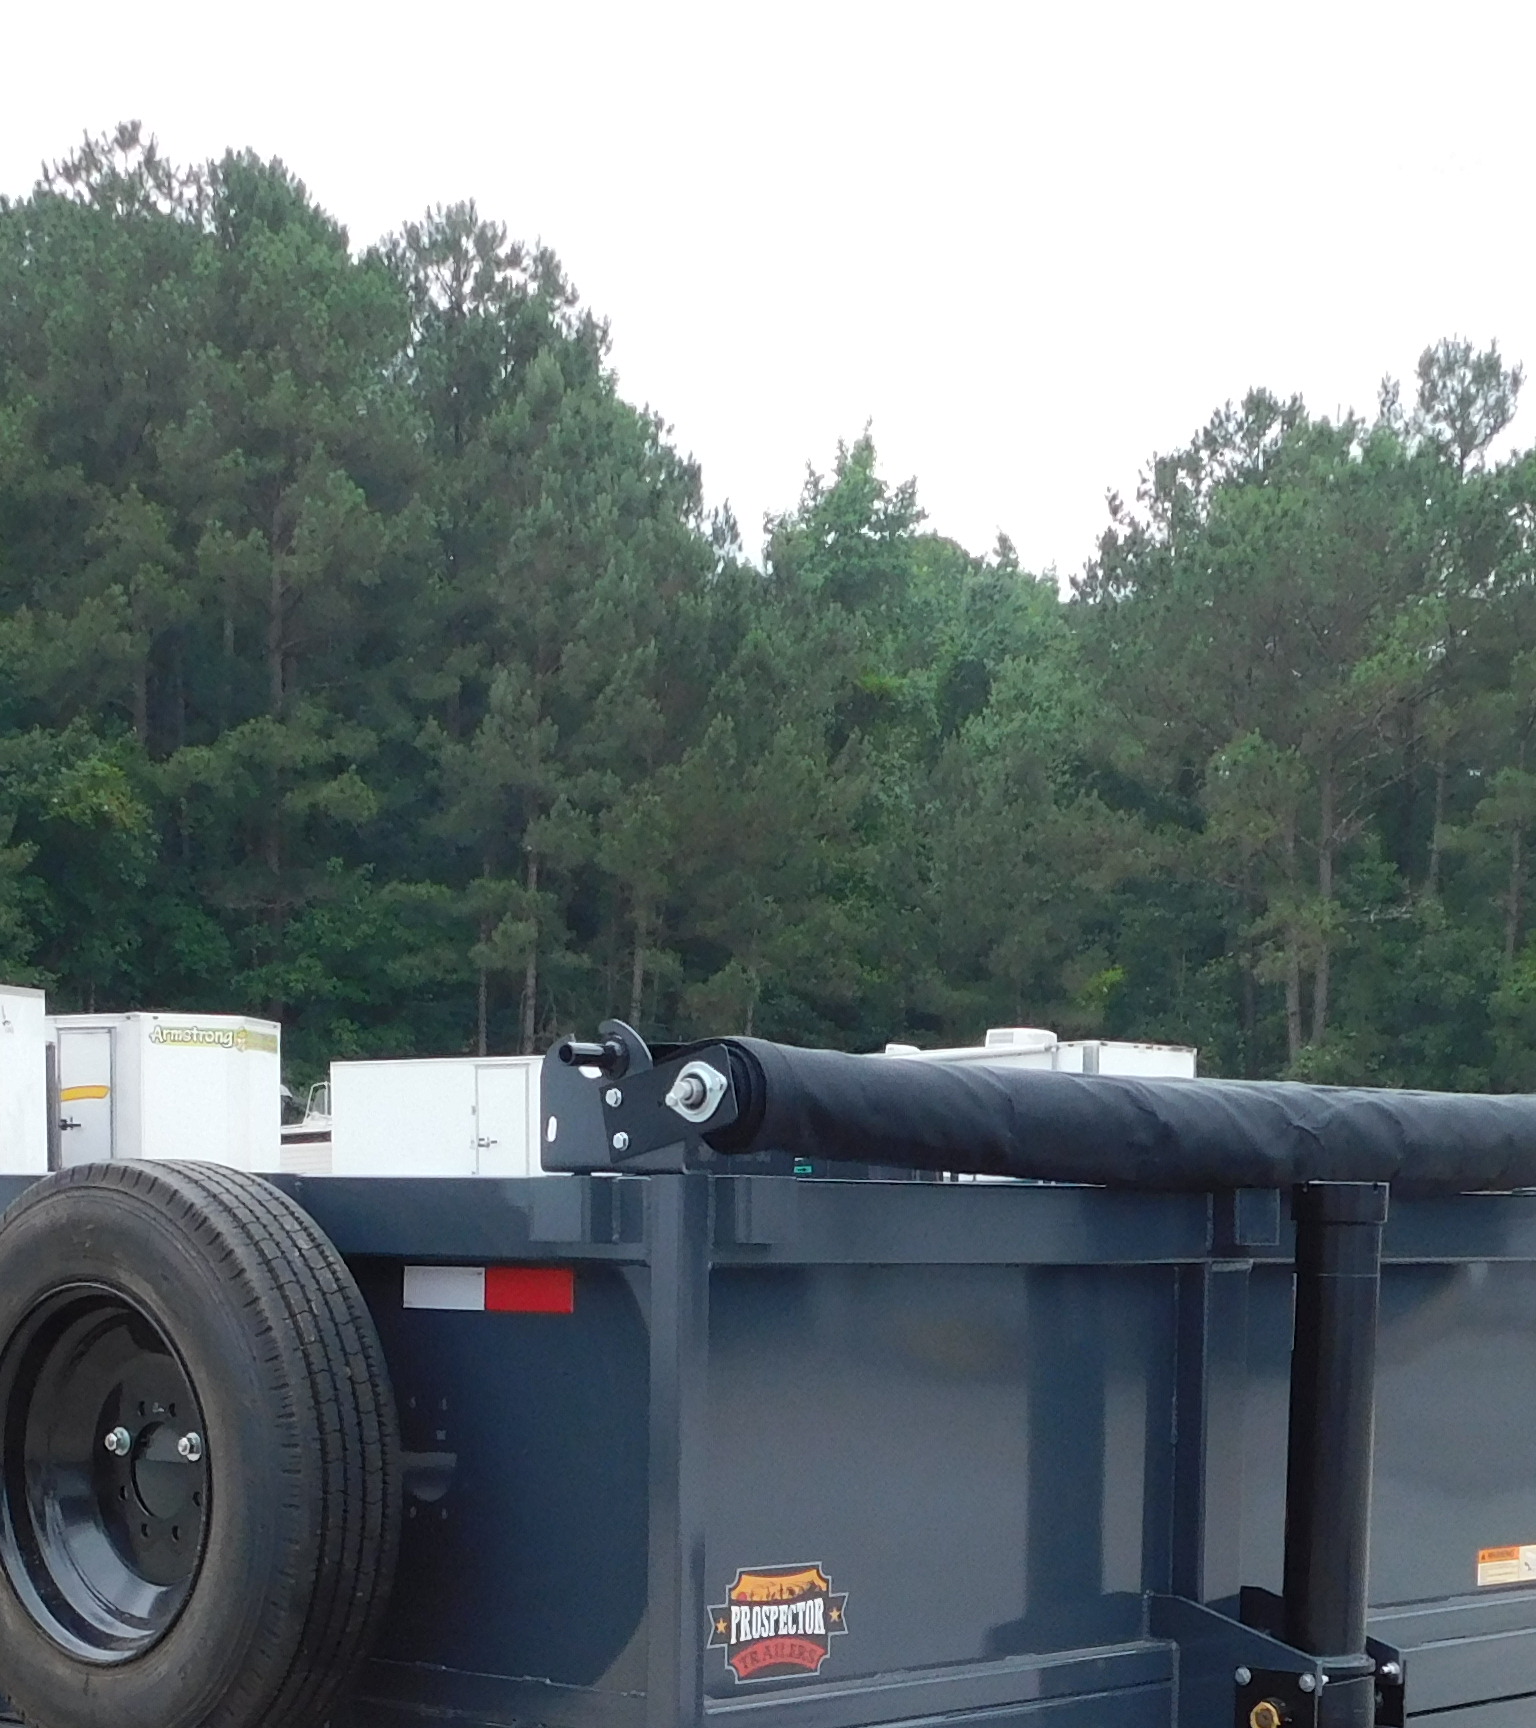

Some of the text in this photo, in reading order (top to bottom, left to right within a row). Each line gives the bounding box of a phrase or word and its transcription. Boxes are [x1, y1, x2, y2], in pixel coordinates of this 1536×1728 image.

[149, 1024, 234, 1048] Armstrong
[730, 1597, 826, 1645] PROSPECTOR
[737, 1640, 817, 1669] TRAILERS
